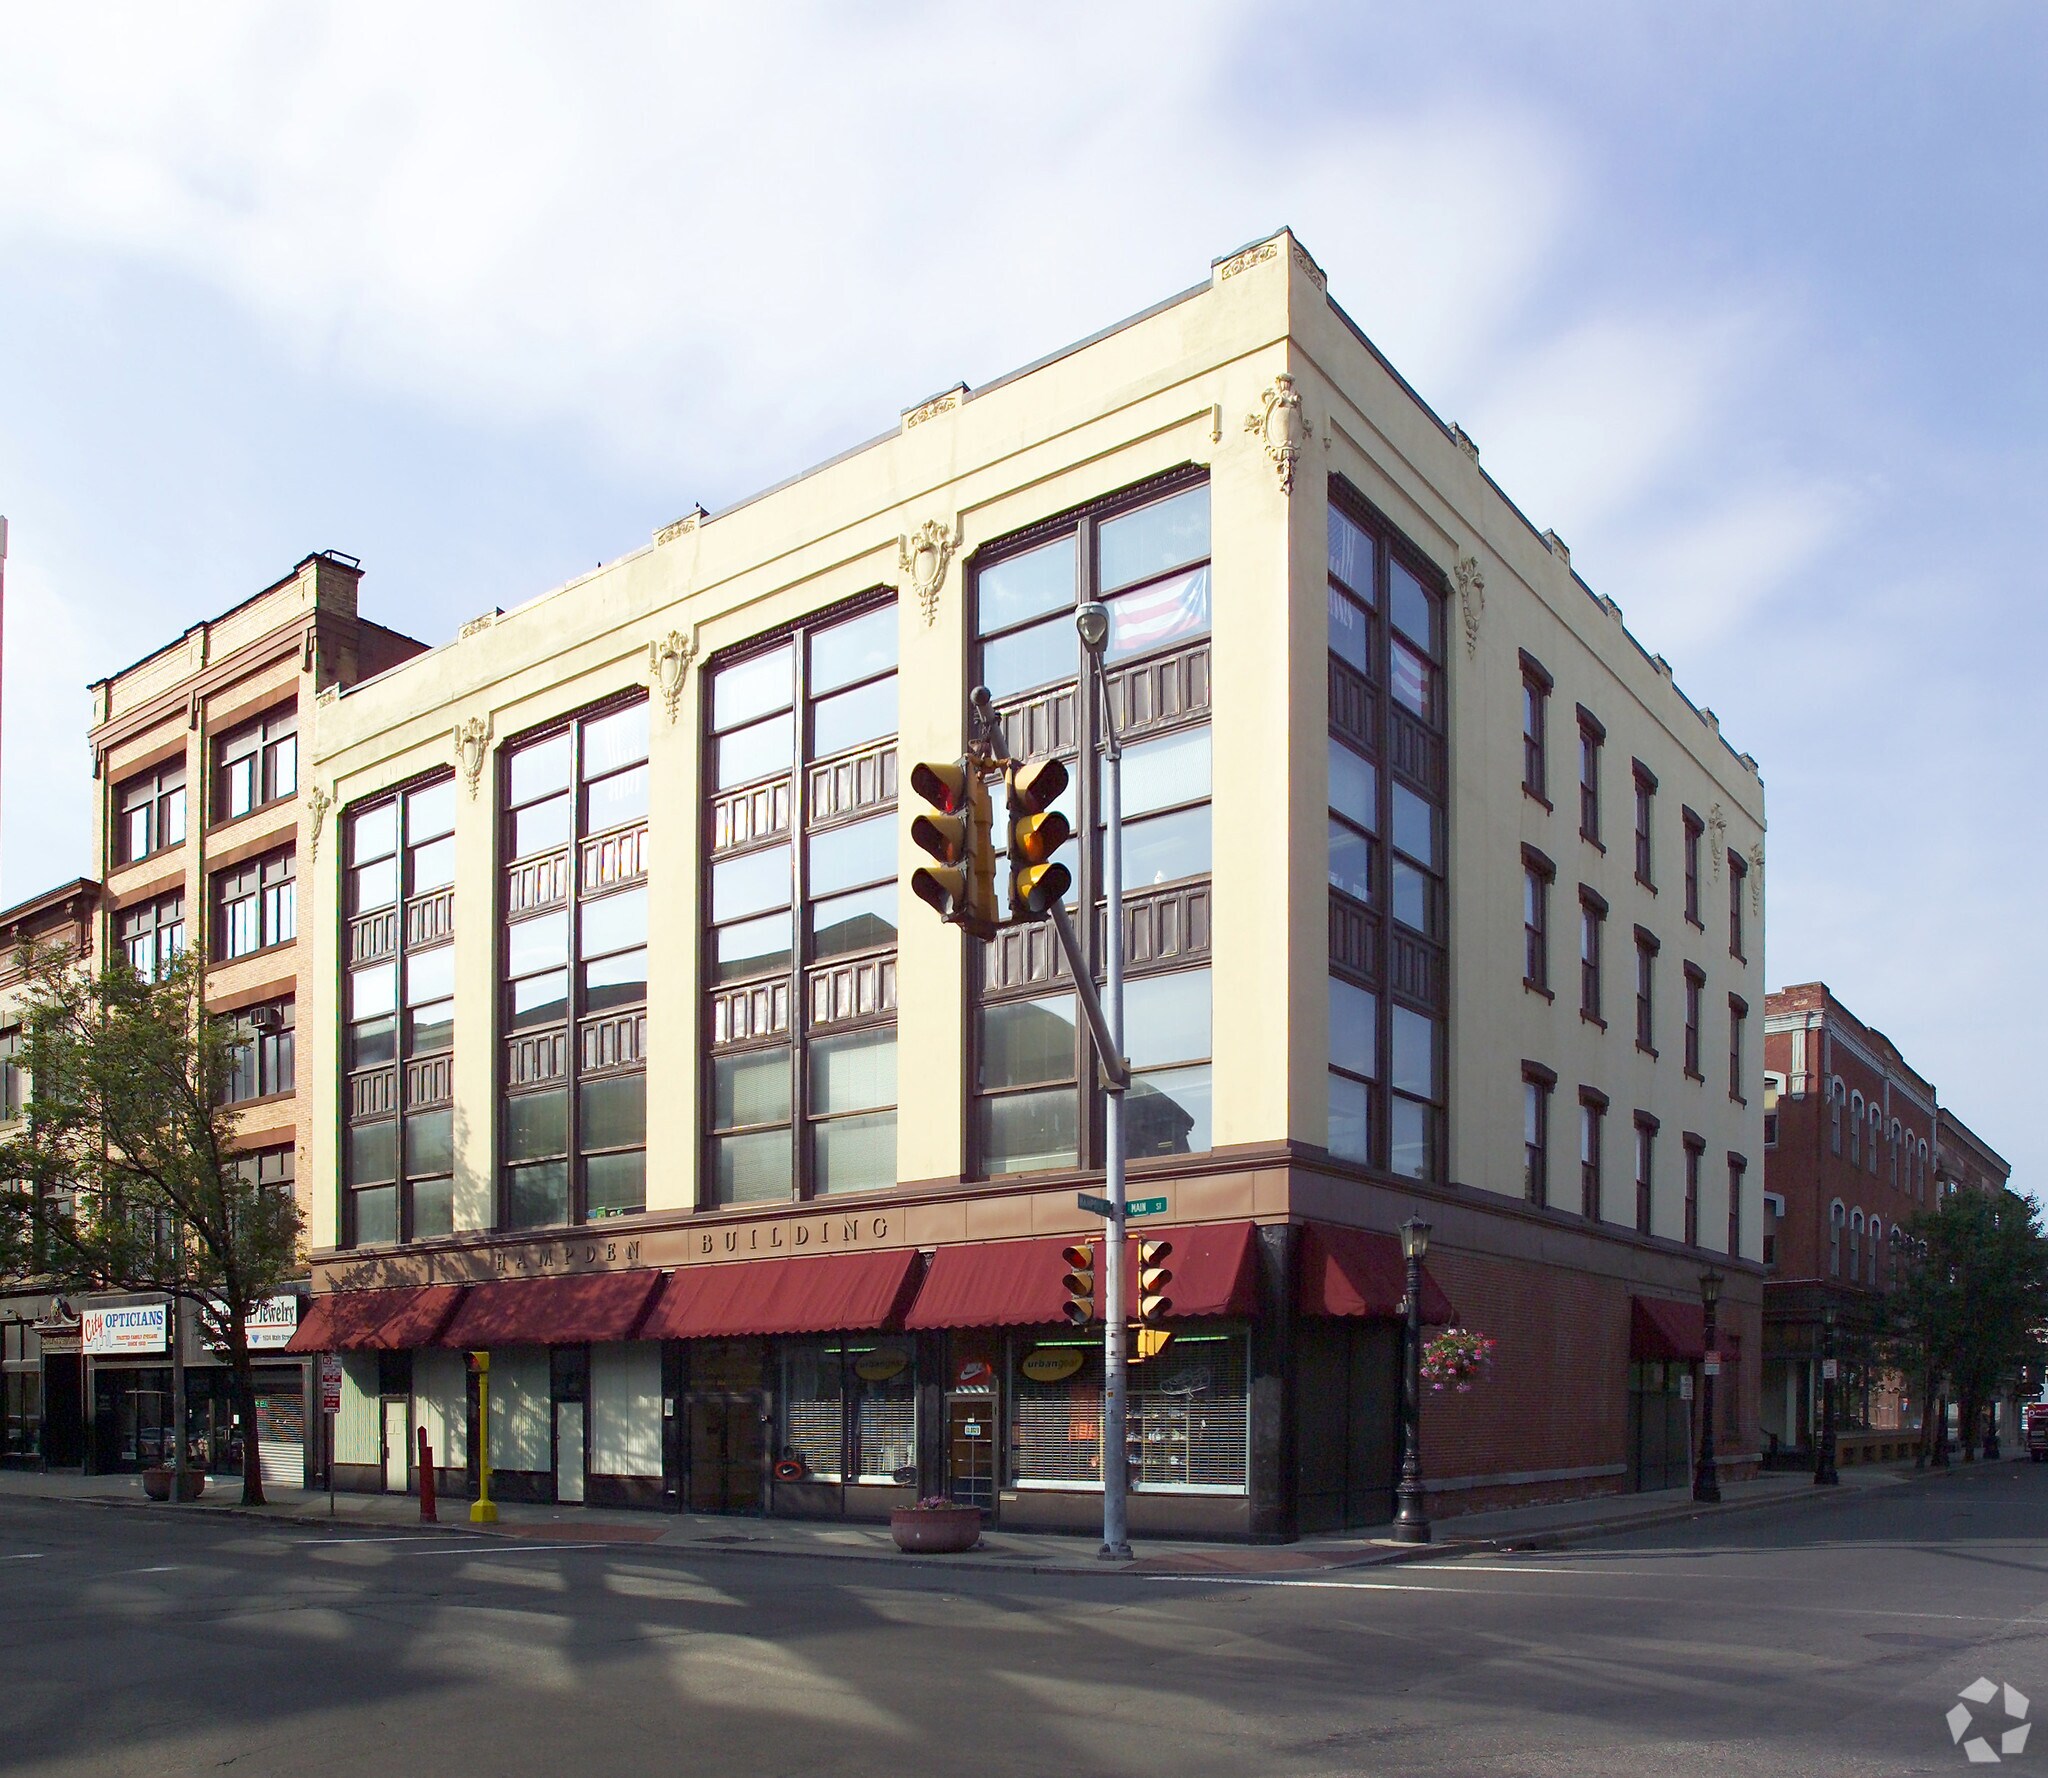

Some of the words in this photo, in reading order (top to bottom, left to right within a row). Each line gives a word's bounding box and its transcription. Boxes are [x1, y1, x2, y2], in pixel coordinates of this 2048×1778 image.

[1131, 1202, 1147, 1213] MAIN
[1155, 1202, 1162, 1211] ST
[496, 1240, 640, 1271] HAMPDEN
[701, 1217, 888, 1254] BUILDING
[85, 1312, 103, 1342] City
[105, 1310, 163, 1328] OPTICIANS
[258, 1301, 295, 1326] Jewelry
